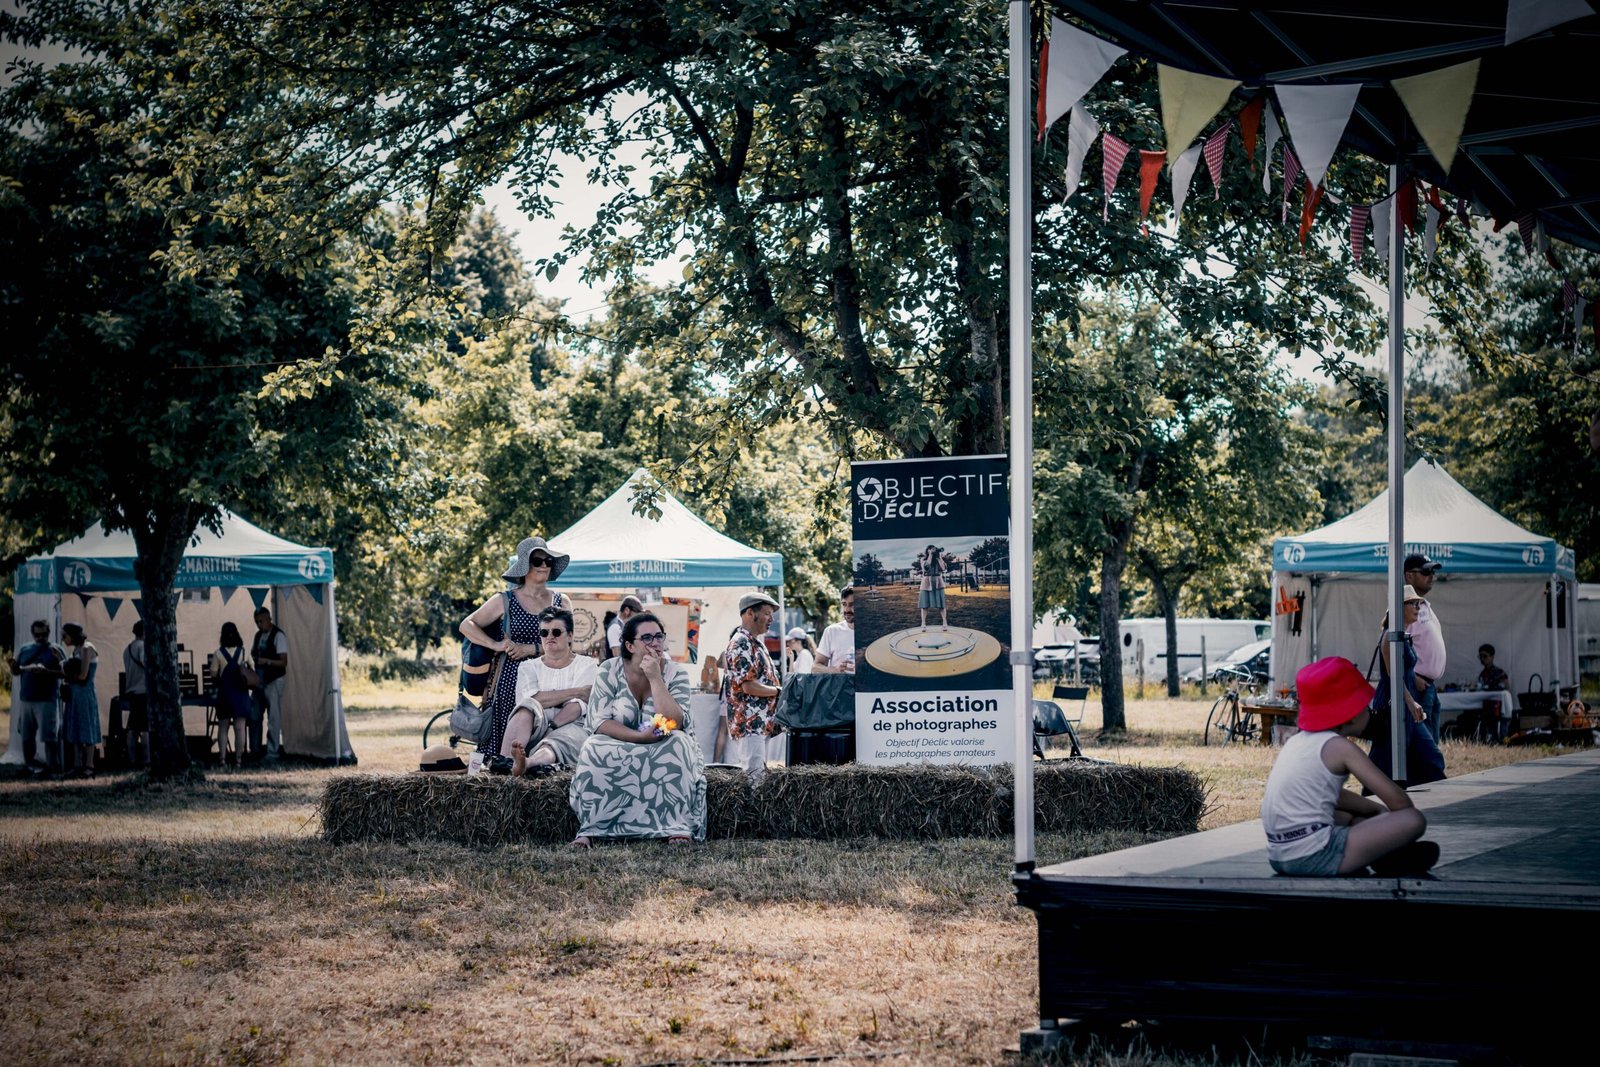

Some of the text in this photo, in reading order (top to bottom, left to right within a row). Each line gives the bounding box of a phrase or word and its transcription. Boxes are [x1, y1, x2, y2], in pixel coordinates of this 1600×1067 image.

[856, 473, 1003, 502] OBJECTIF
[859, 498, 950, 521] DÉCLIC
[1285, 544, 1302, 563] 76
[1524, 547, 1541, 566] 76
[65, 563, 87, 586] 76
[300, 557, 320, 578] 76
[608, 560, 686, 574] SEINE-MARITIME
[753, 560, 769, 579] 76
[870, 695, 998, 714] Association
[873, 718, 998, 734] de photographes
[885, 737, 985, 749] Objectif Déclic valorise
[874, 748, 996, 760] les photographes amateurs
